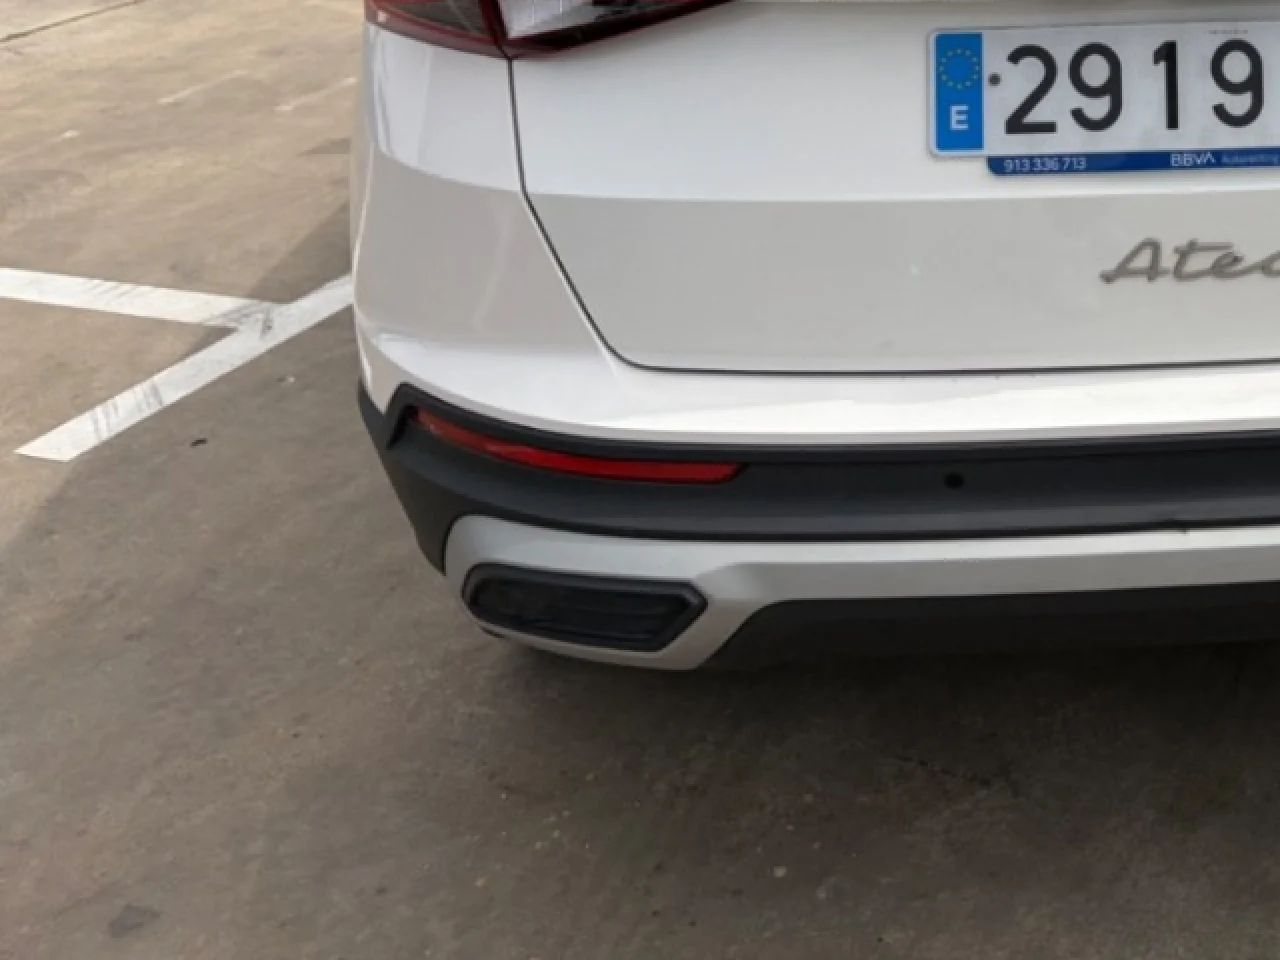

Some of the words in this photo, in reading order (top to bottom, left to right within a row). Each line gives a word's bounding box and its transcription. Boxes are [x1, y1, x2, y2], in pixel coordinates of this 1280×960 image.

[1004, 39, 1265, 136] 2919
[949, 105, 969, 131] E
[1003, 158, 1030, 173] 913
[1062, 156, 1087, 171] 713
[1170, 151, 1217, 167] BBVA
